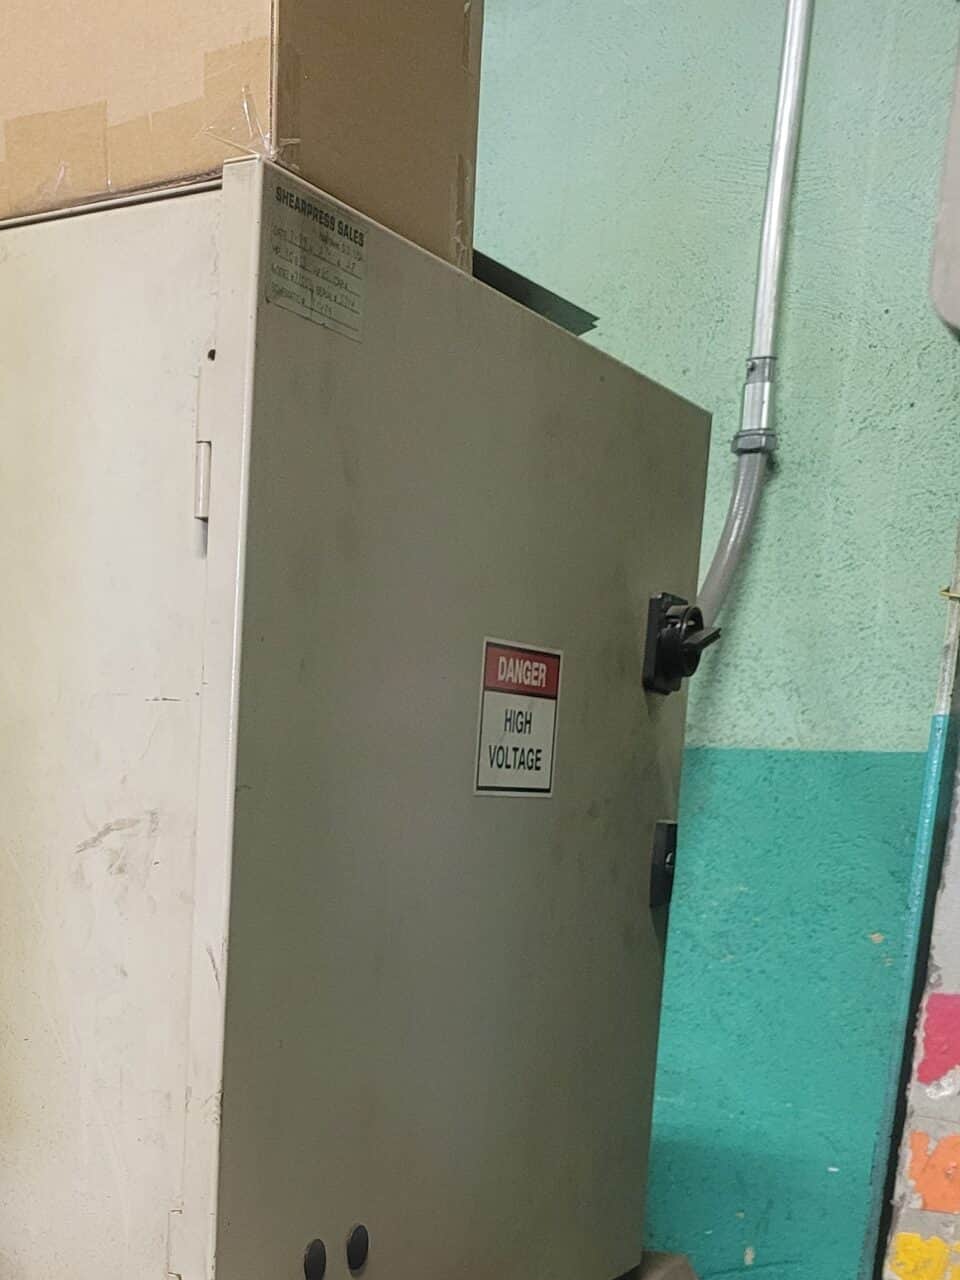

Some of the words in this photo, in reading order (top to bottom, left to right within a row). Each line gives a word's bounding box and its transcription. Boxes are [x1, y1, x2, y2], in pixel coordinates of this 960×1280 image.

[275, 186, 336, 231] SHEARPRESS
[338, 220, 365, 248] SALES
[497, 656, 547, 688] DANGER
[504, 708, 532, 735] HIGH
[489, 745, 542, 771] VOLTAGE
